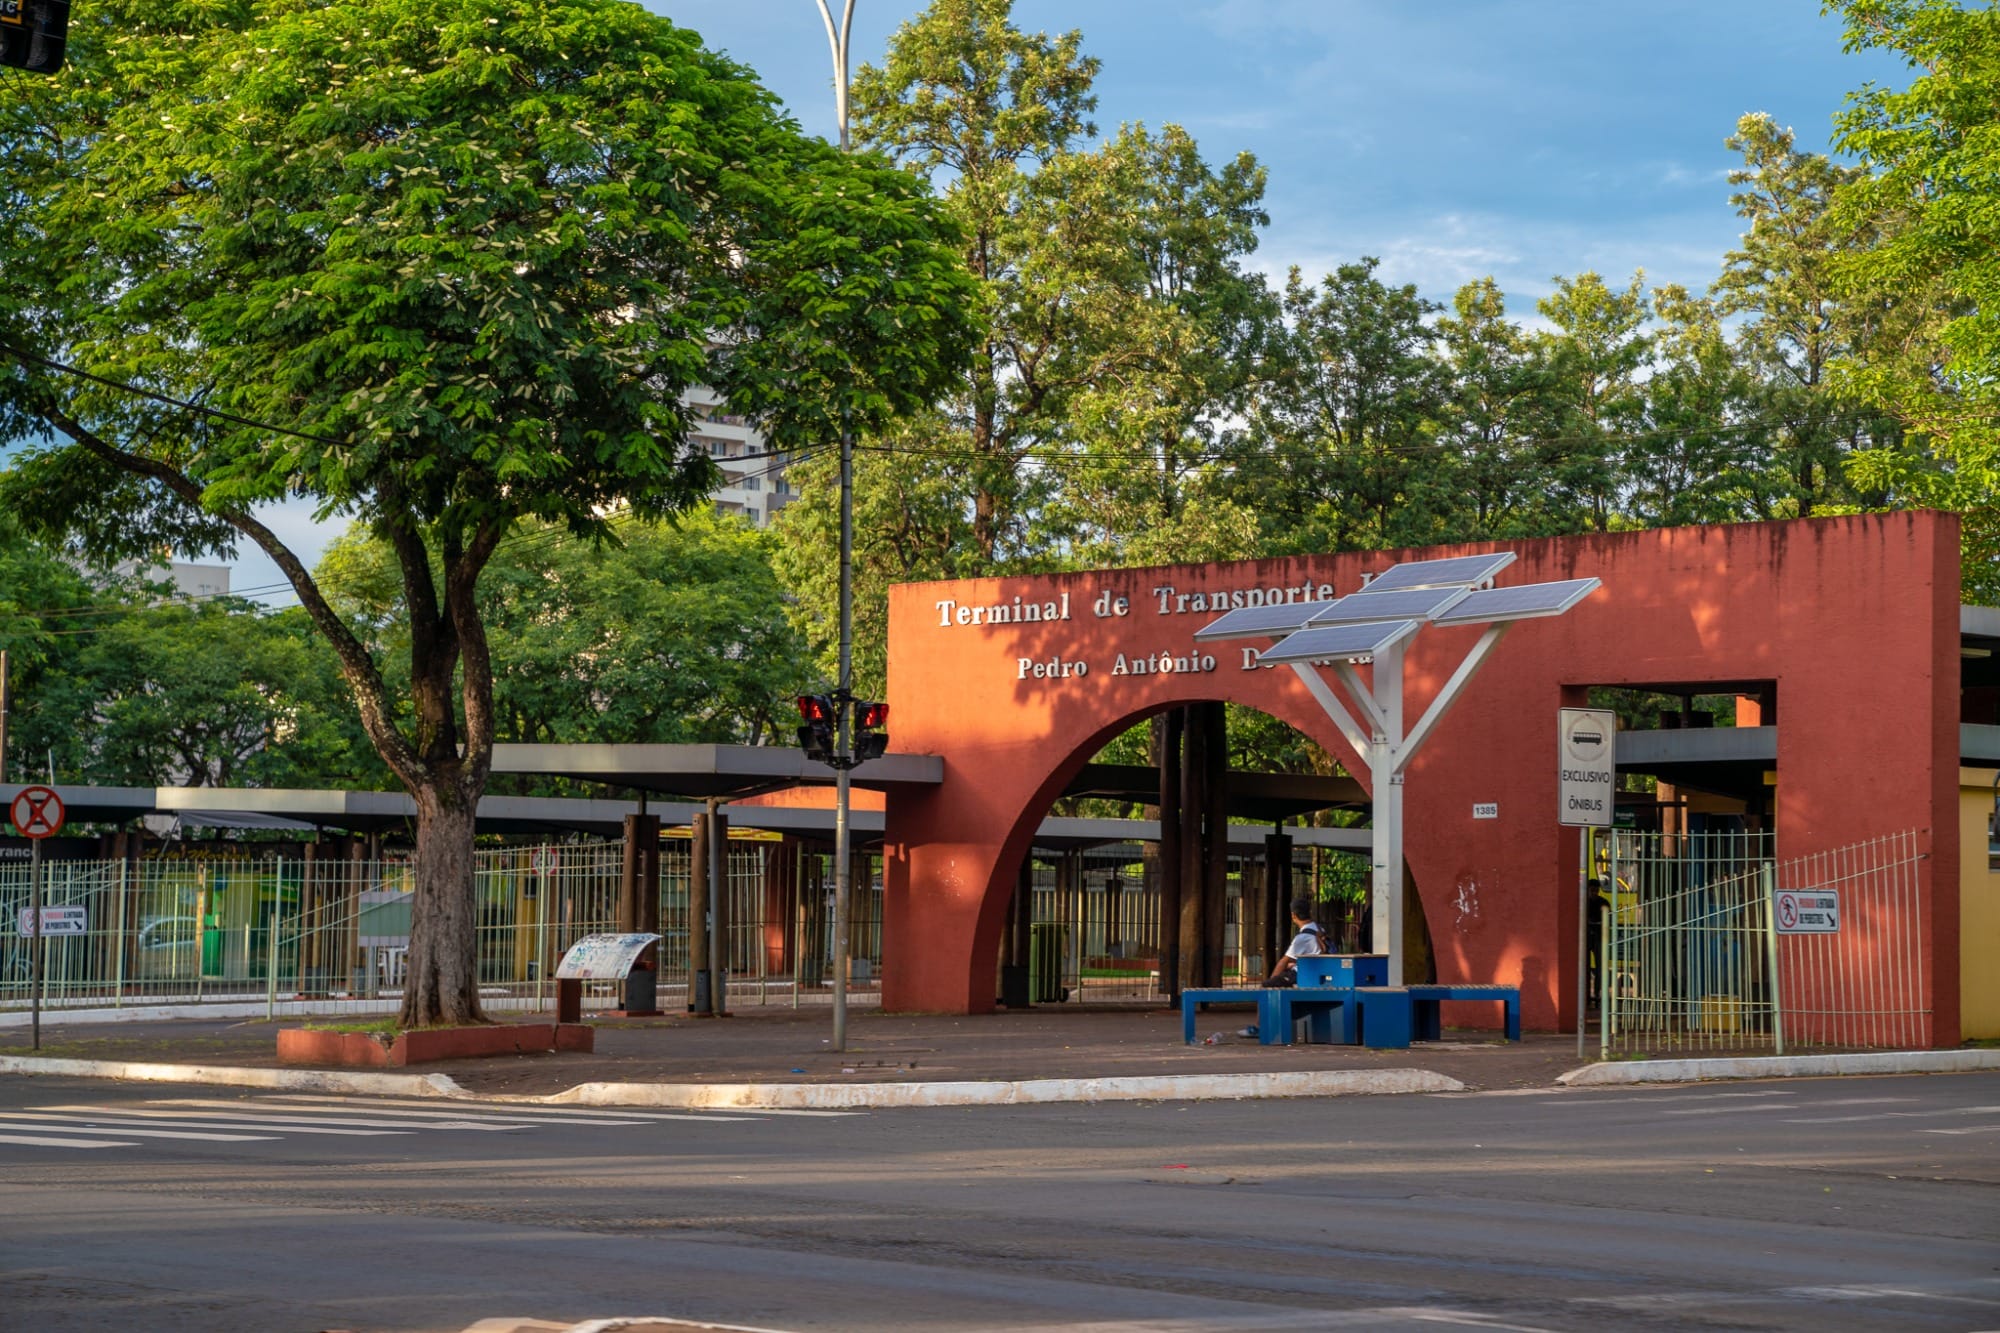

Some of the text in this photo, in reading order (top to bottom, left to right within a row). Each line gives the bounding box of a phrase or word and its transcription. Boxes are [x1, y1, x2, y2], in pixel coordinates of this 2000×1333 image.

[936, 592, 1071, 627] Terminal
[1093, 589, 1130, 617] de
[1153, 579, 1334, 615] Transporte
[1017, 656, 1088, 680] Pedro
[1111, 650, 1216, 676] Antônio
[1562, 769, 1611, 784] EXCLUSIVO
[1475, 806, 1496, 816] 1385
[1568, 794, 1603, 812] ÔNIBUS
